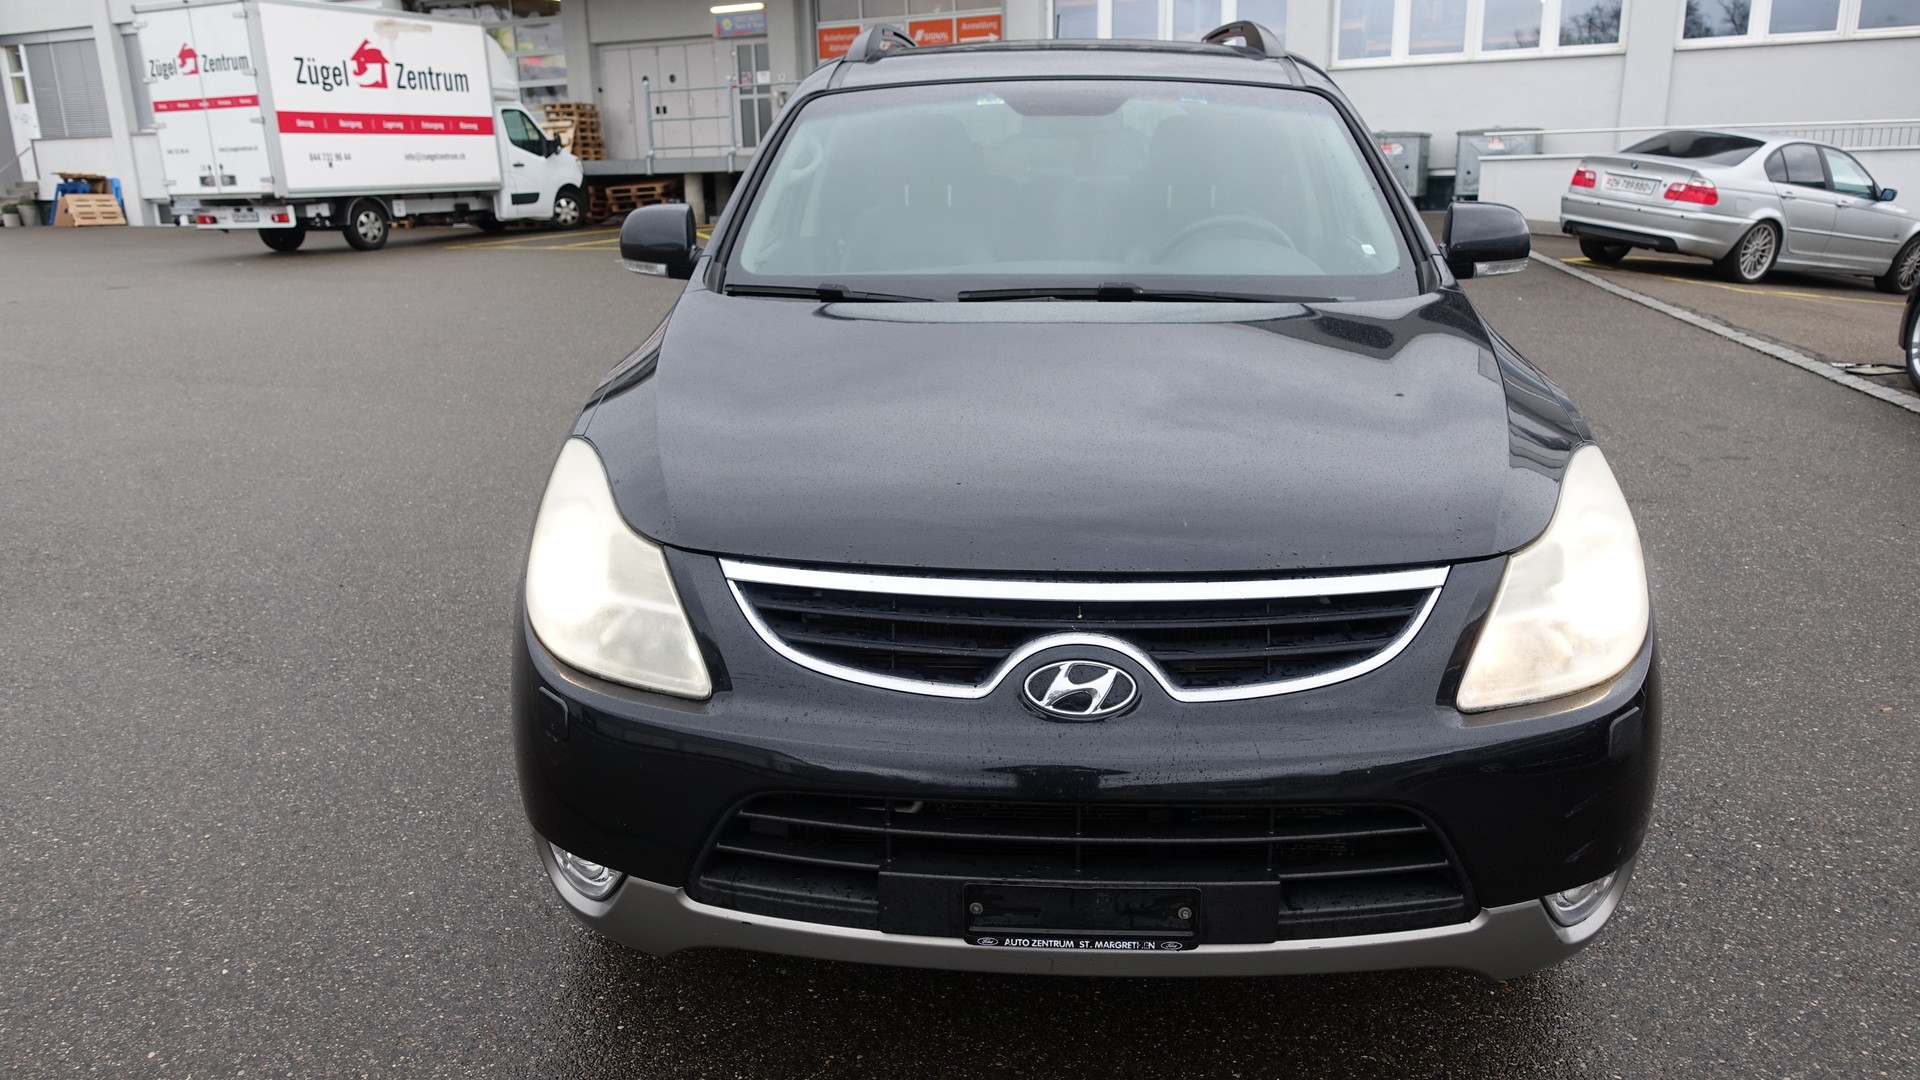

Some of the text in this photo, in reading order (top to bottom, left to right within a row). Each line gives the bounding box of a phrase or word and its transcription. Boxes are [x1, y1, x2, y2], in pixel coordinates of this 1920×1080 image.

[961, 21, 998, 31] Anmeldung
[149, 54, 250, 80] Zügel Zentrum
[294, 57, 470, 92] Zügel Zentrum
[1004, 938, 1030, 947] AUTO
[1031, 940, 1075, 948] ZENTRUM
[1079, 941, 1093, 949] ST.
